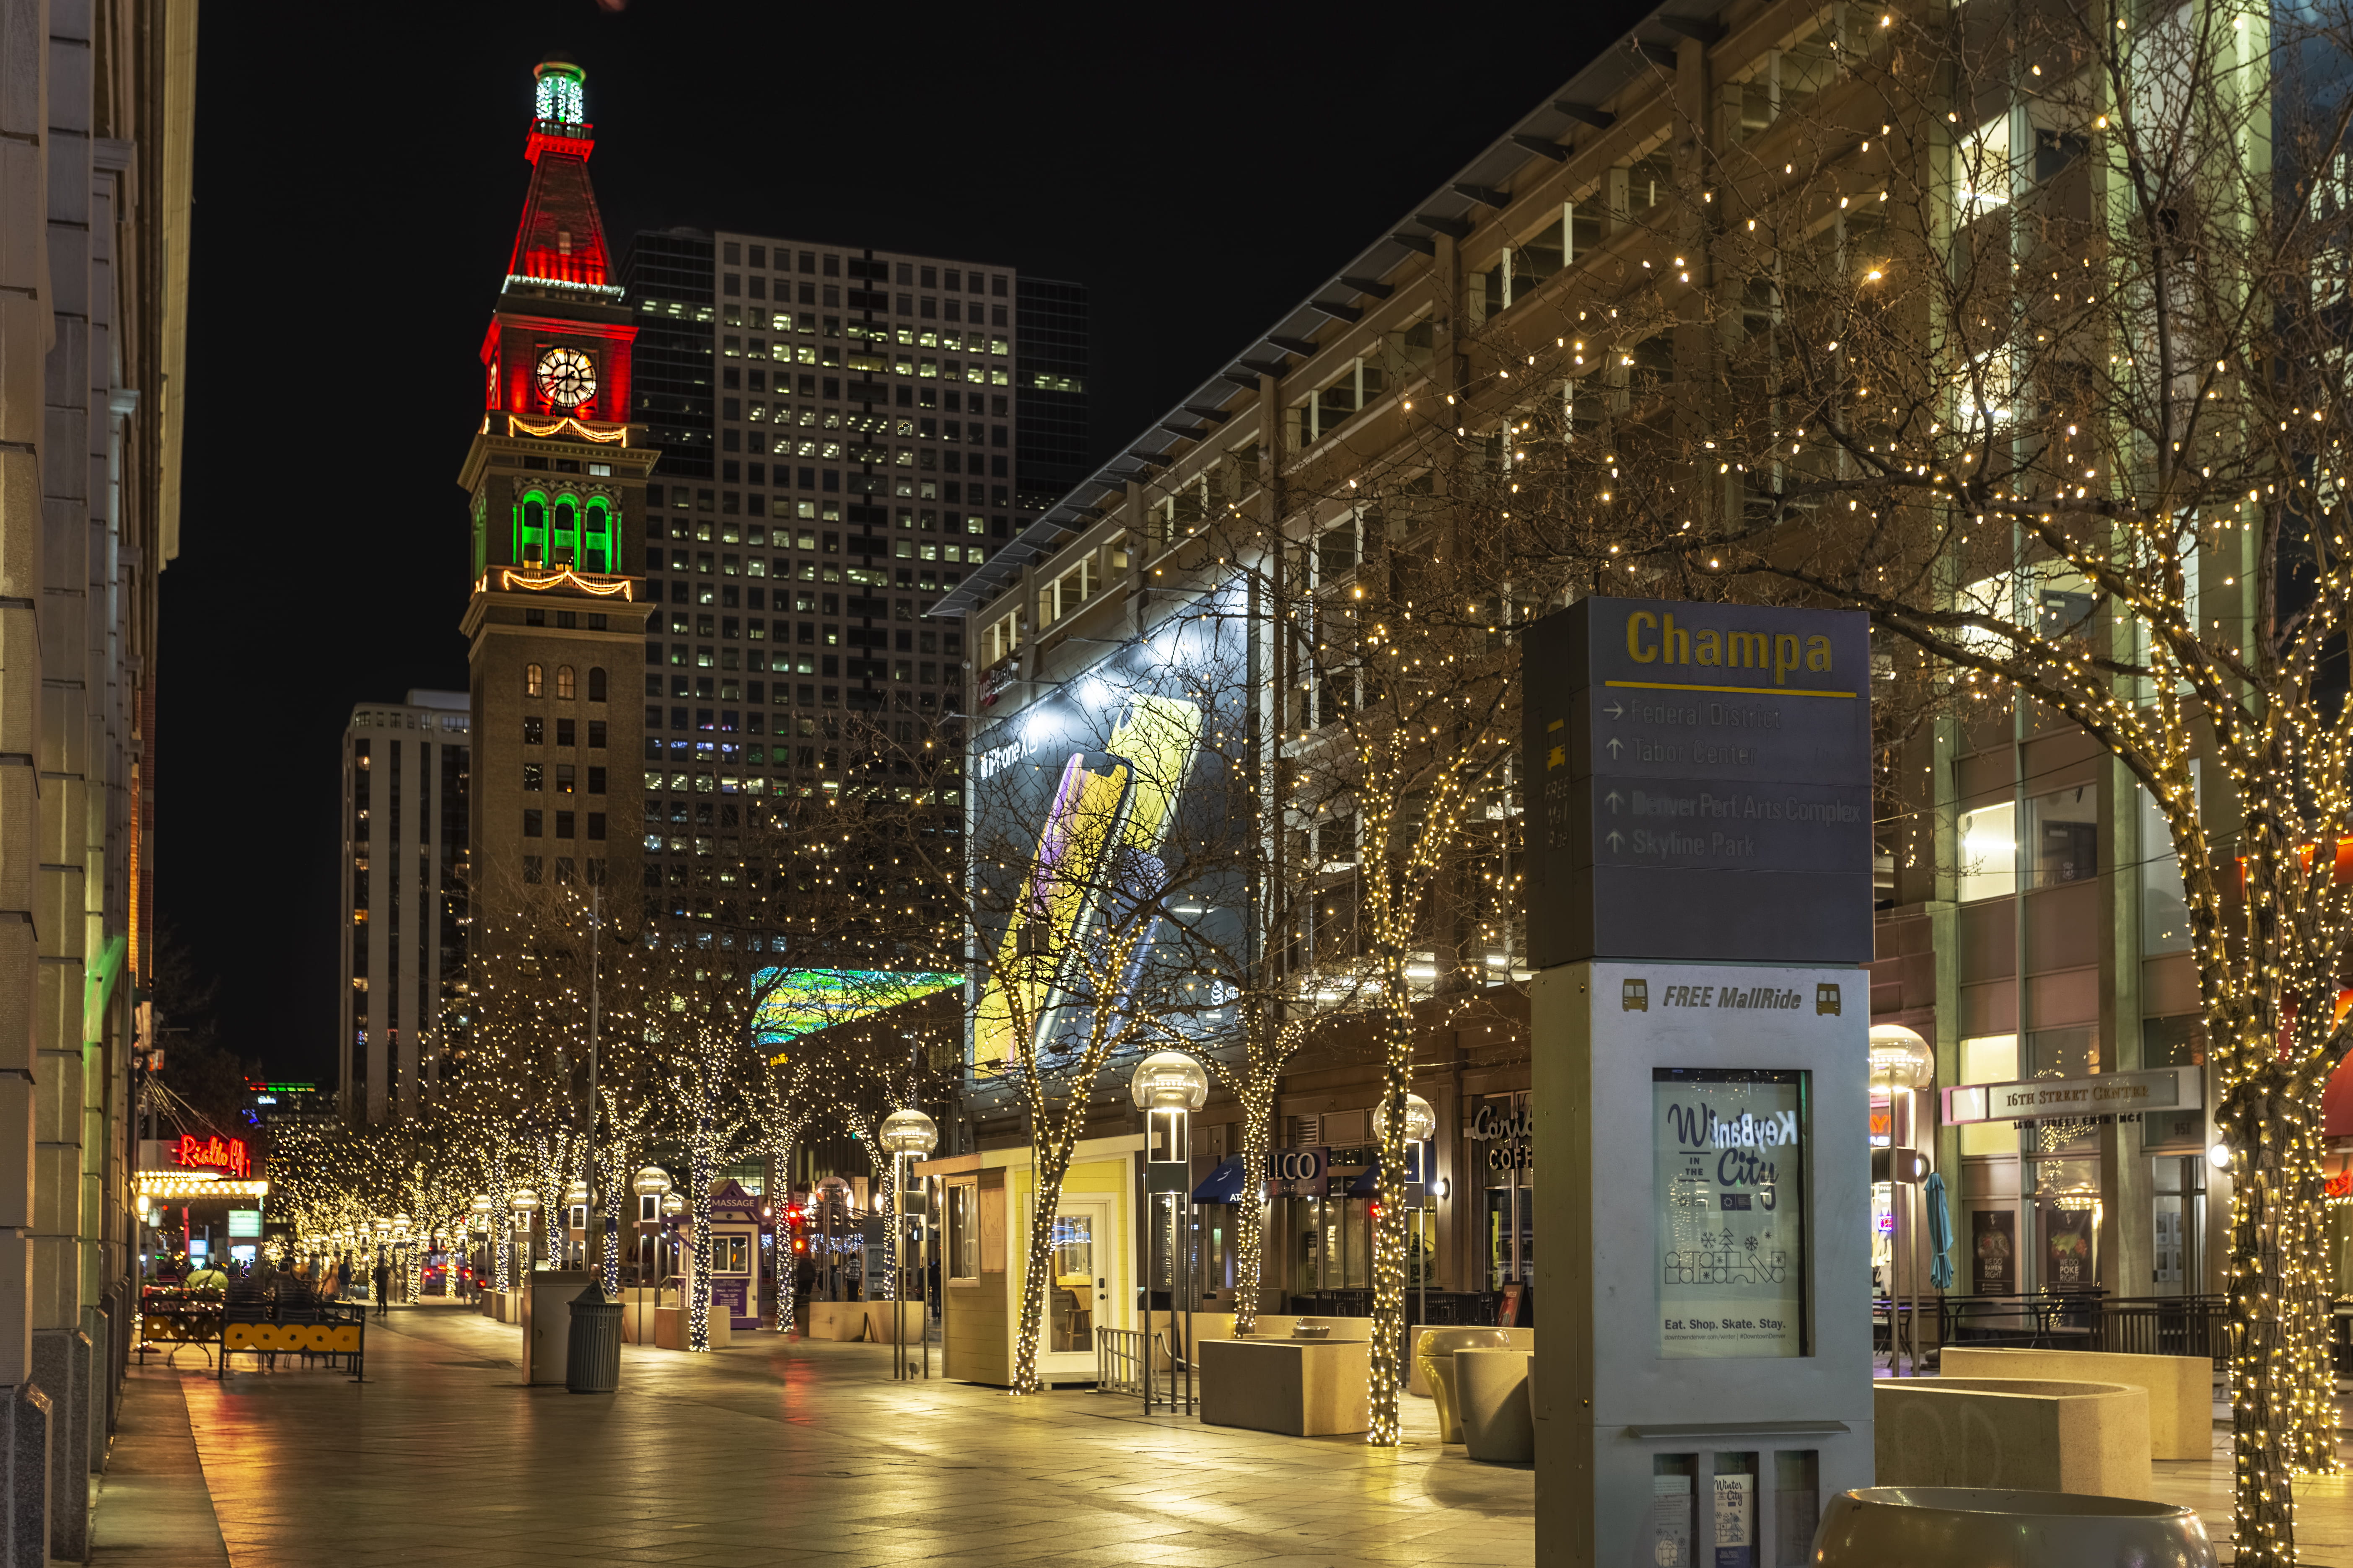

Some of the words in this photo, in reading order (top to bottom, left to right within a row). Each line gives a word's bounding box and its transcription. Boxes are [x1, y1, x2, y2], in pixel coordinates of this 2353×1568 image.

[1626, 610, 1832, 685] Champa
[1631, 699, 1703, 725] Federal
[1710, 702, 1781, 729] District
[1631, 737, 1685, 763] Tabor
[1693, 740, 1757, 766] Center
[1545, 776, 1569, 802] FREE
[1547, 801, 1568, 827] Mal
[1632, 790, 1697, 817] Denver
[1700, 792, 1741, 818] Perf.
[1743, 795, 1782, 820] Arts
[1785, 796, 1861, 827] Complex
[1633, 829, 1705, 860] Skyline
[1712, 832, 1755, 857] Park
[1663, 986, 1714, 1008] FREE
[2006, 1093, 2035, 1107] 16TH
[2039, 1089, 2088, 1105] STREET
[1474, 1105, 1532, 1141] Carib
[181, 1134, 228, 1168] Rialto
[1489, 1148, 1532, 1170] COFF
[1263, 1152, 1316, 1180] LLCO
[1718, 1148, 1779, 1211] City
[2060, 1266, 2079, 1274] POKE
[1665, 1320, 1686, 1329] Eat.
[1689, 1320, 1718, 1331] Shop.
[1721, 1319, 1756, 1329] Skate.
[1759, 1319, 1786, 1330] Stay.
[1714, 1479, 1743, 1491] Winter
[1727, 1490, 1742, 1506] City
